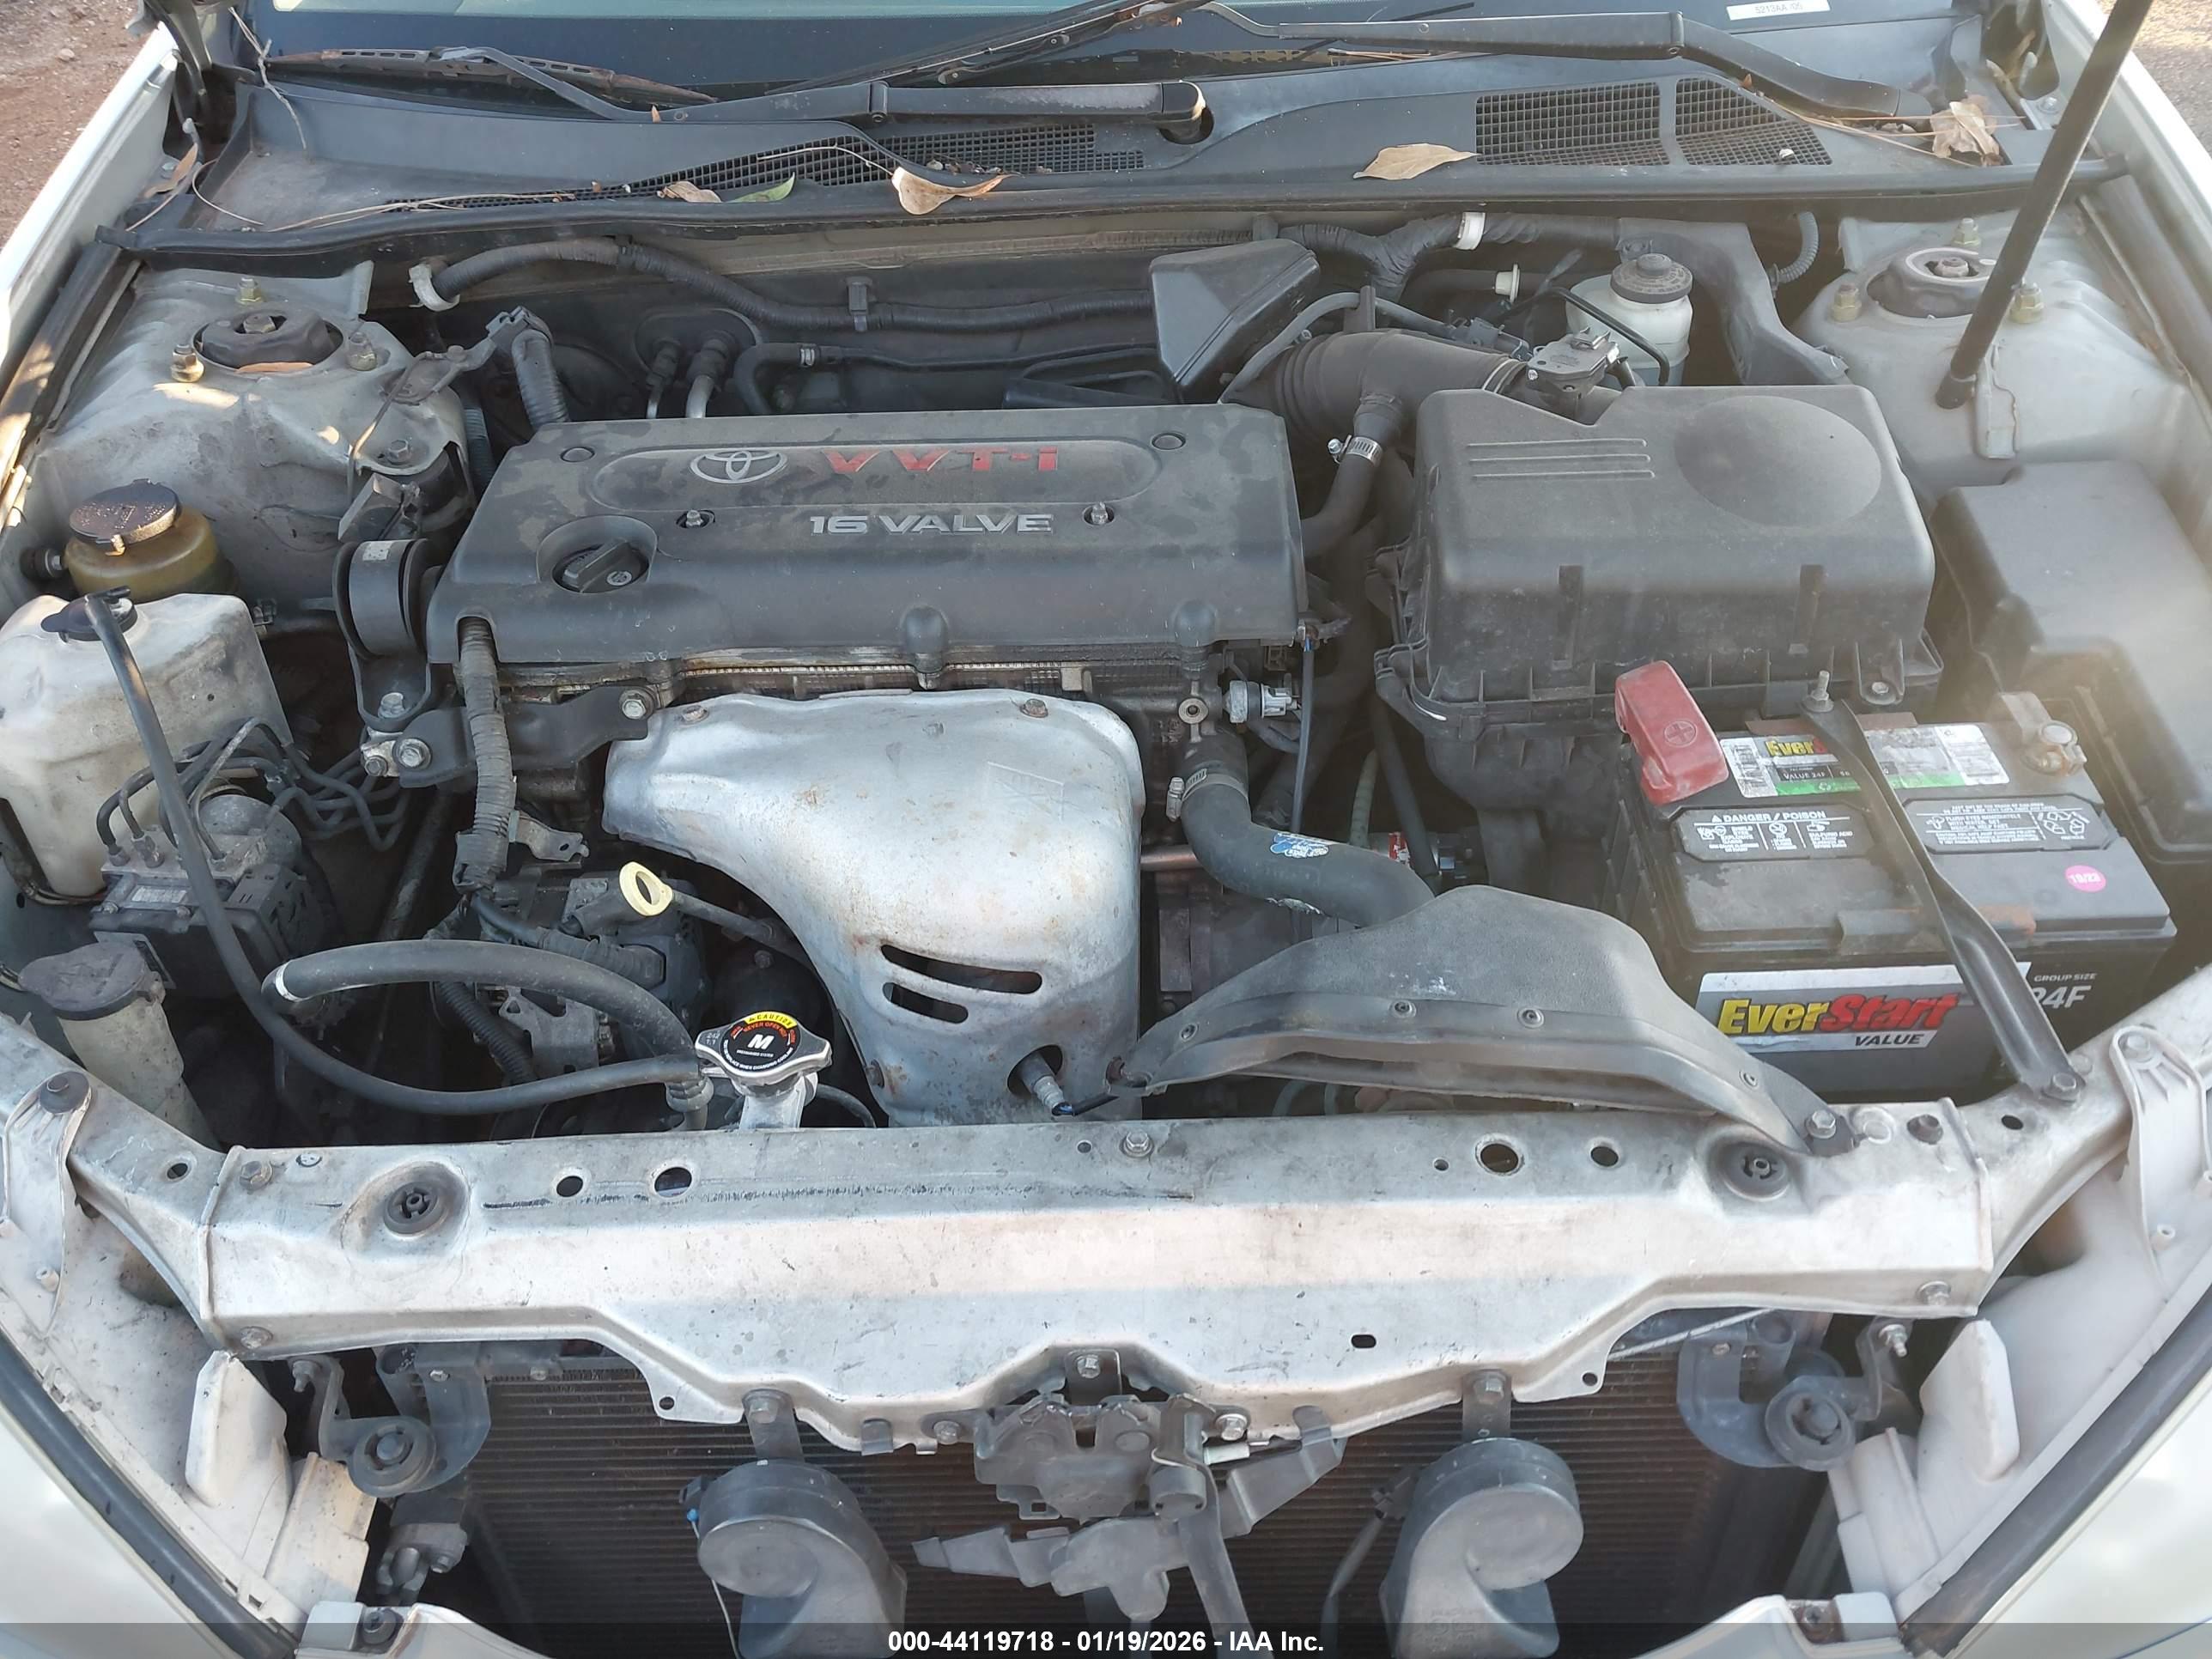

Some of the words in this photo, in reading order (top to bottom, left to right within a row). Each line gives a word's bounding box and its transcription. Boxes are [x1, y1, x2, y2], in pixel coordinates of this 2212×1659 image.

[810, 515, 868, 535] 16
[879, 514, 1054, 534] VALVE
[1723, 813, 1772, 823] DANGER
[1782, 810, 1827, 820] POISON
[1717, 993, 1960, 1035] EverStart
[747, 1033, 775, 1050] M
[1855, 1033, 1924, 1047] VALUE
